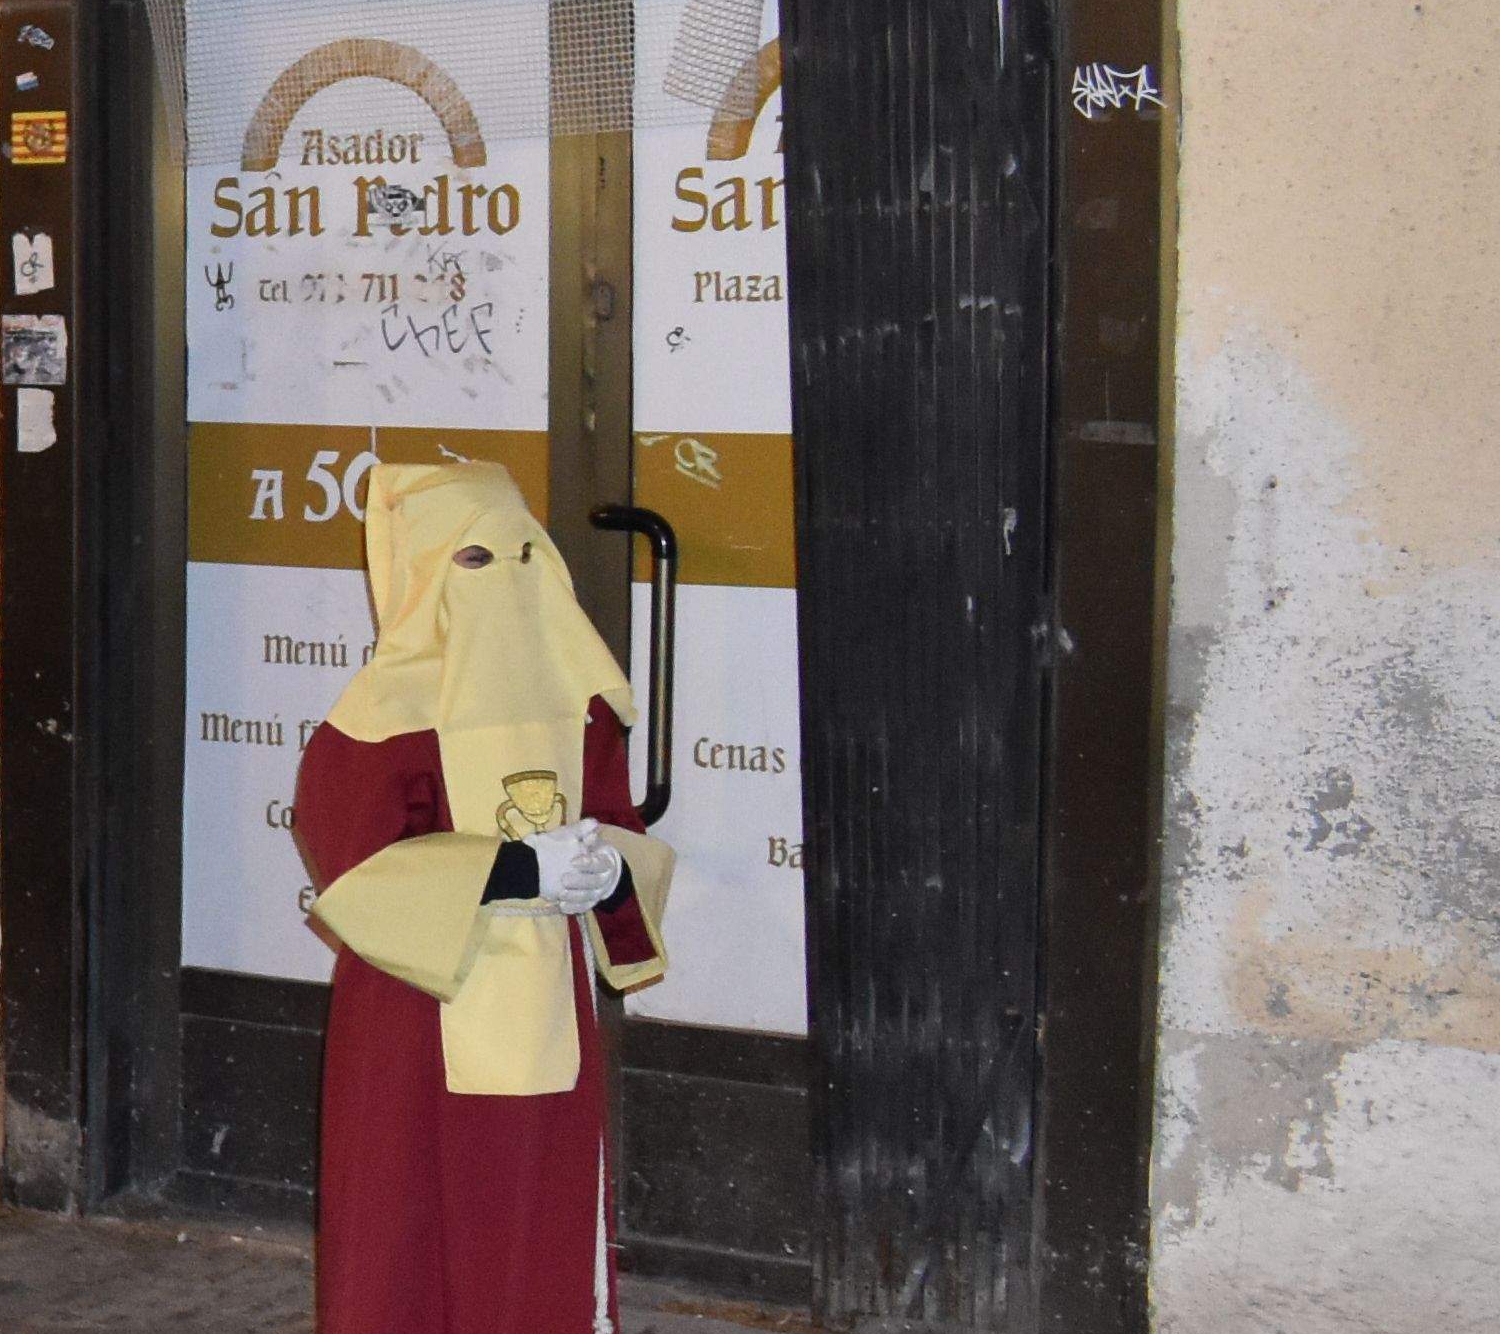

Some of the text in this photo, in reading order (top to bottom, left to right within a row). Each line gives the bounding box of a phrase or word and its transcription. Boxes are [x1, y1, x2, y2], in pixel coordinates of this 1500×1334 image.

[300, 129, 424, 167] Asador
[210, 176, 325, 238] San
[361, 273, 400, 303] 711
[693, 271, 783, 303] Plaza
[250, 470, 284, 521] A
[263, 634, 348, 668] Menú
[200, 712, 285, 747] Menú
[693, 737, 786, 774] Cenas
